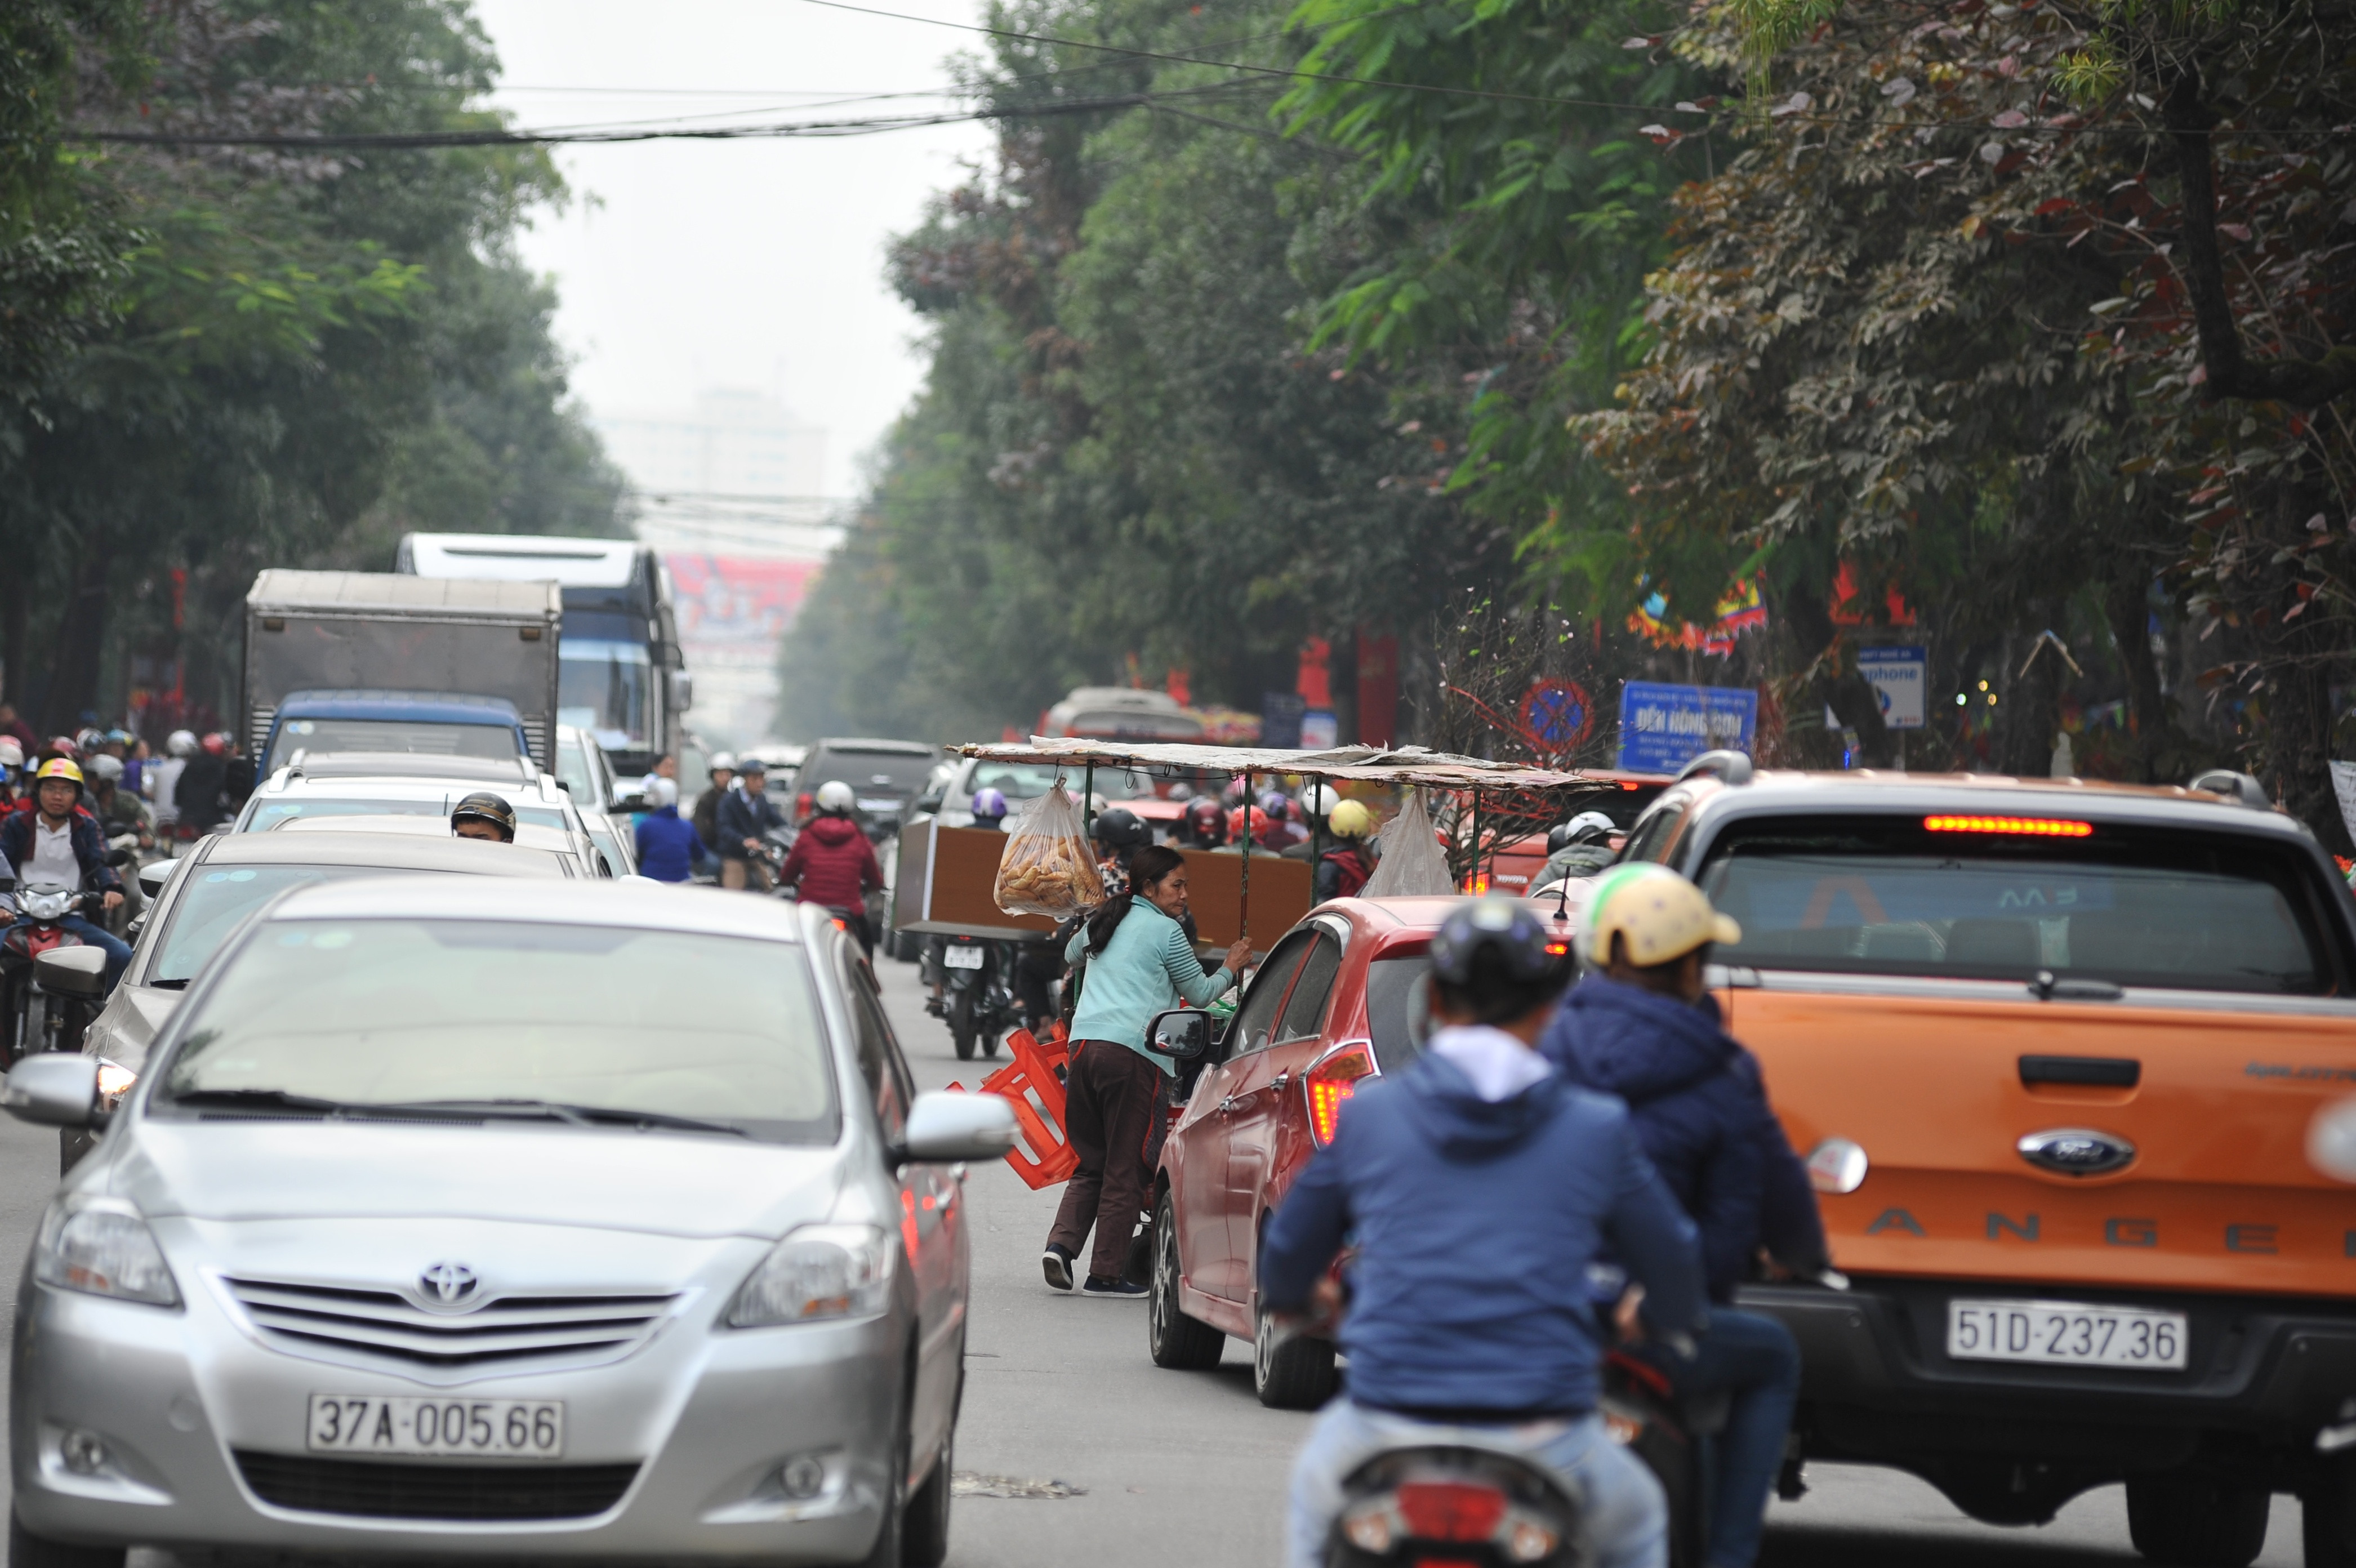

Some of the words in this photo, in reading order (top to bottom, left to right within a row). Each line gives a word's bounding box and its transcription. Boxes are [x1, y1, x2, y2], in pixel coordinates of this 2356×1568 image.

[1866, 1208, 2356, 1258] ANGE
[1959, 1310, 2176, 1361] 51D-237.36
[318, 1400, 556, 1449] 37A-005.66
